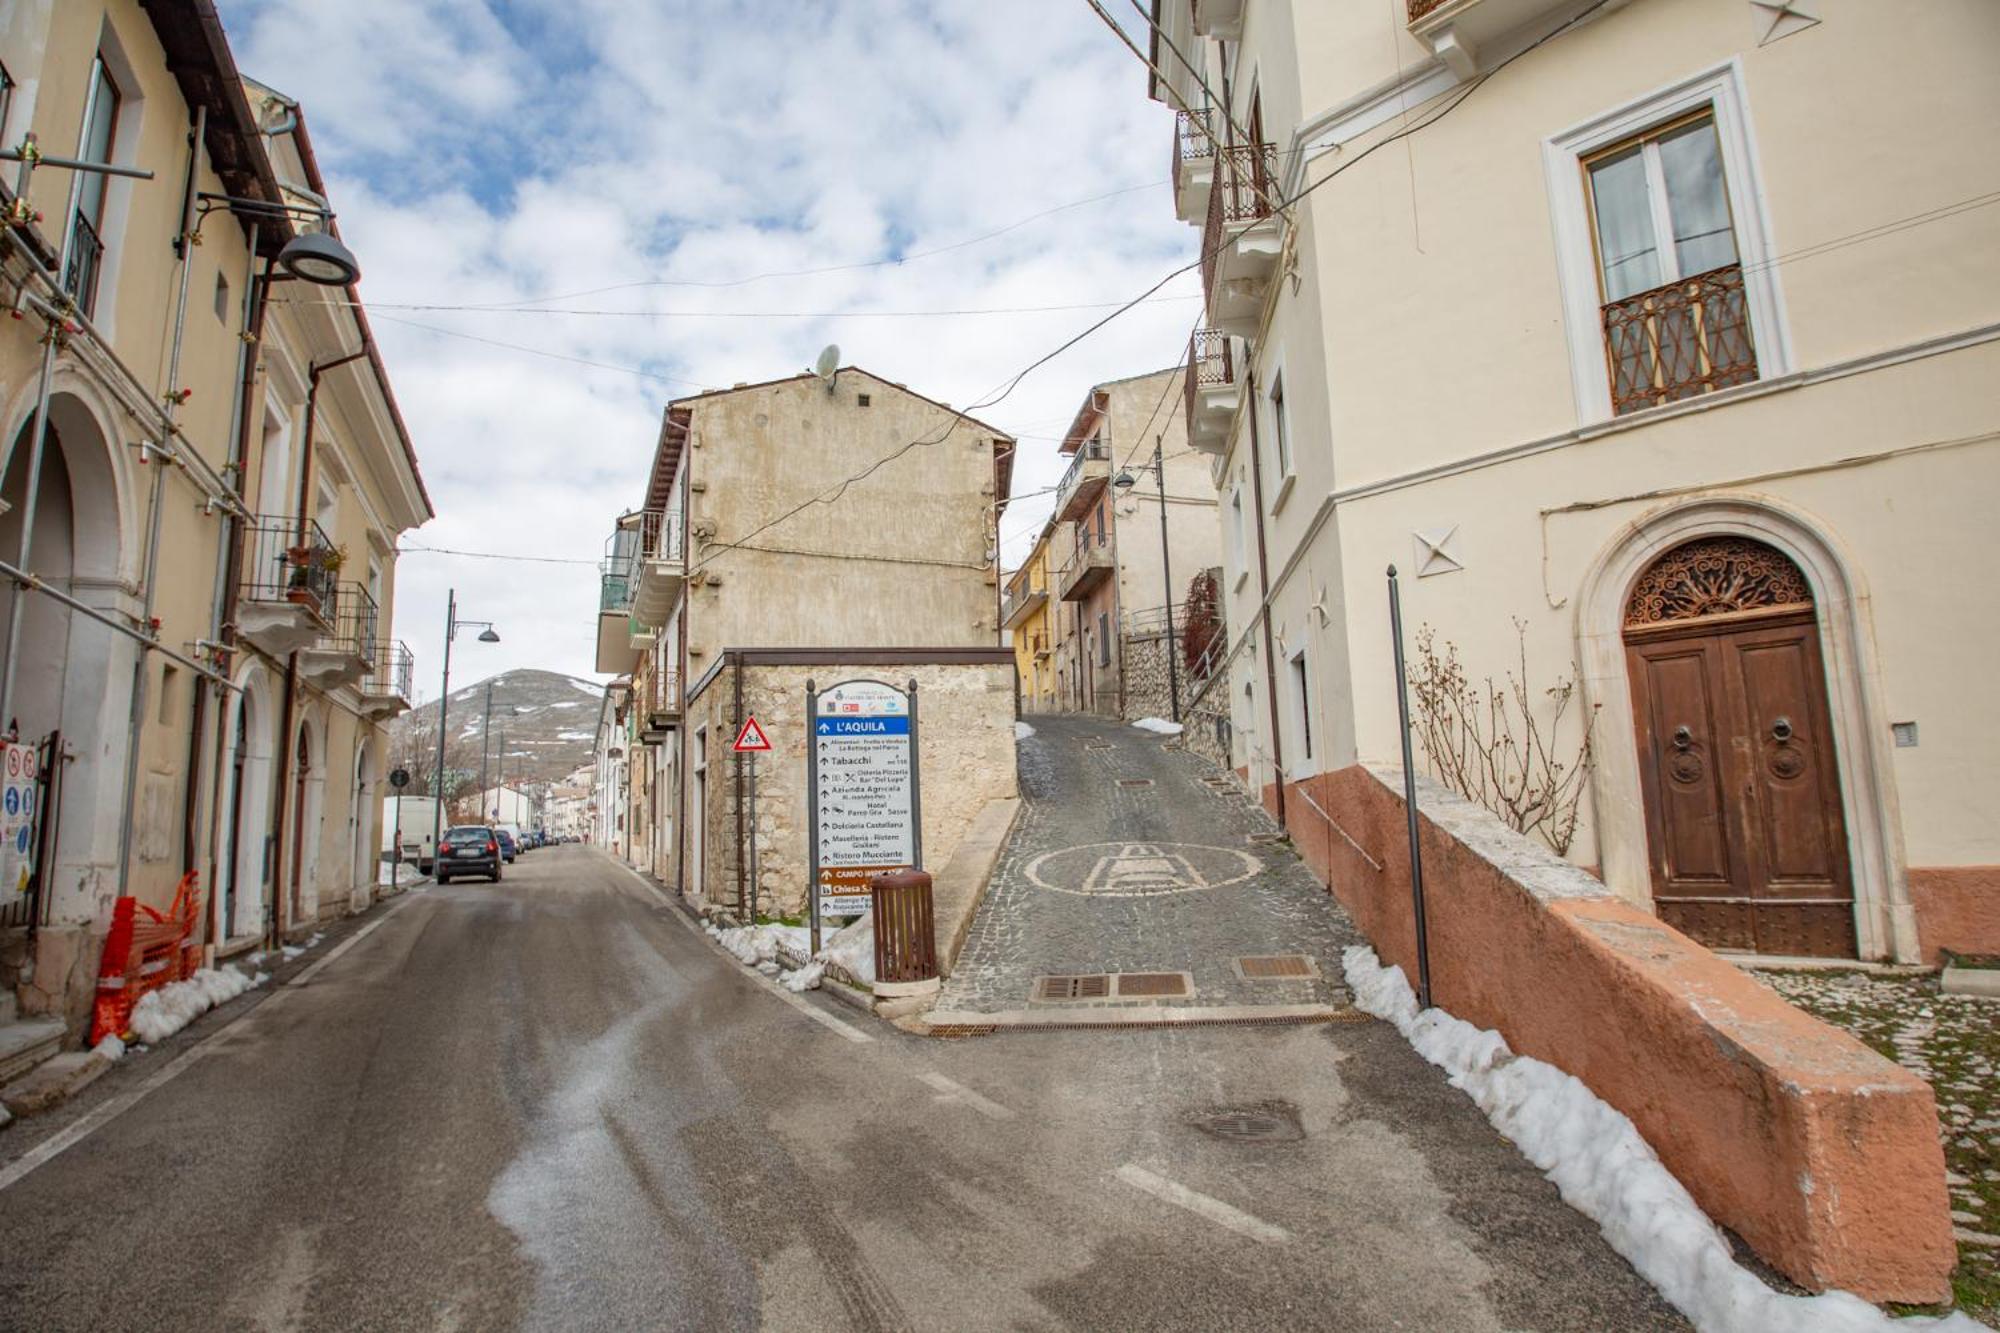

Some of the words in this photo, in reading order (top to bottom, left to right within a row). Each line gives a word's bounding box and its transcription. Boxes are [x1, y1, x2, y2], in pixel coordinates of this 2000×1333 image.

[836, 722, 885, 733] L'AQUILA
[831, 756, 871, 766] Tabacchi
[862, 850, 903, 858] Mucciante
[833, 884, 861, 894] Chiesa
